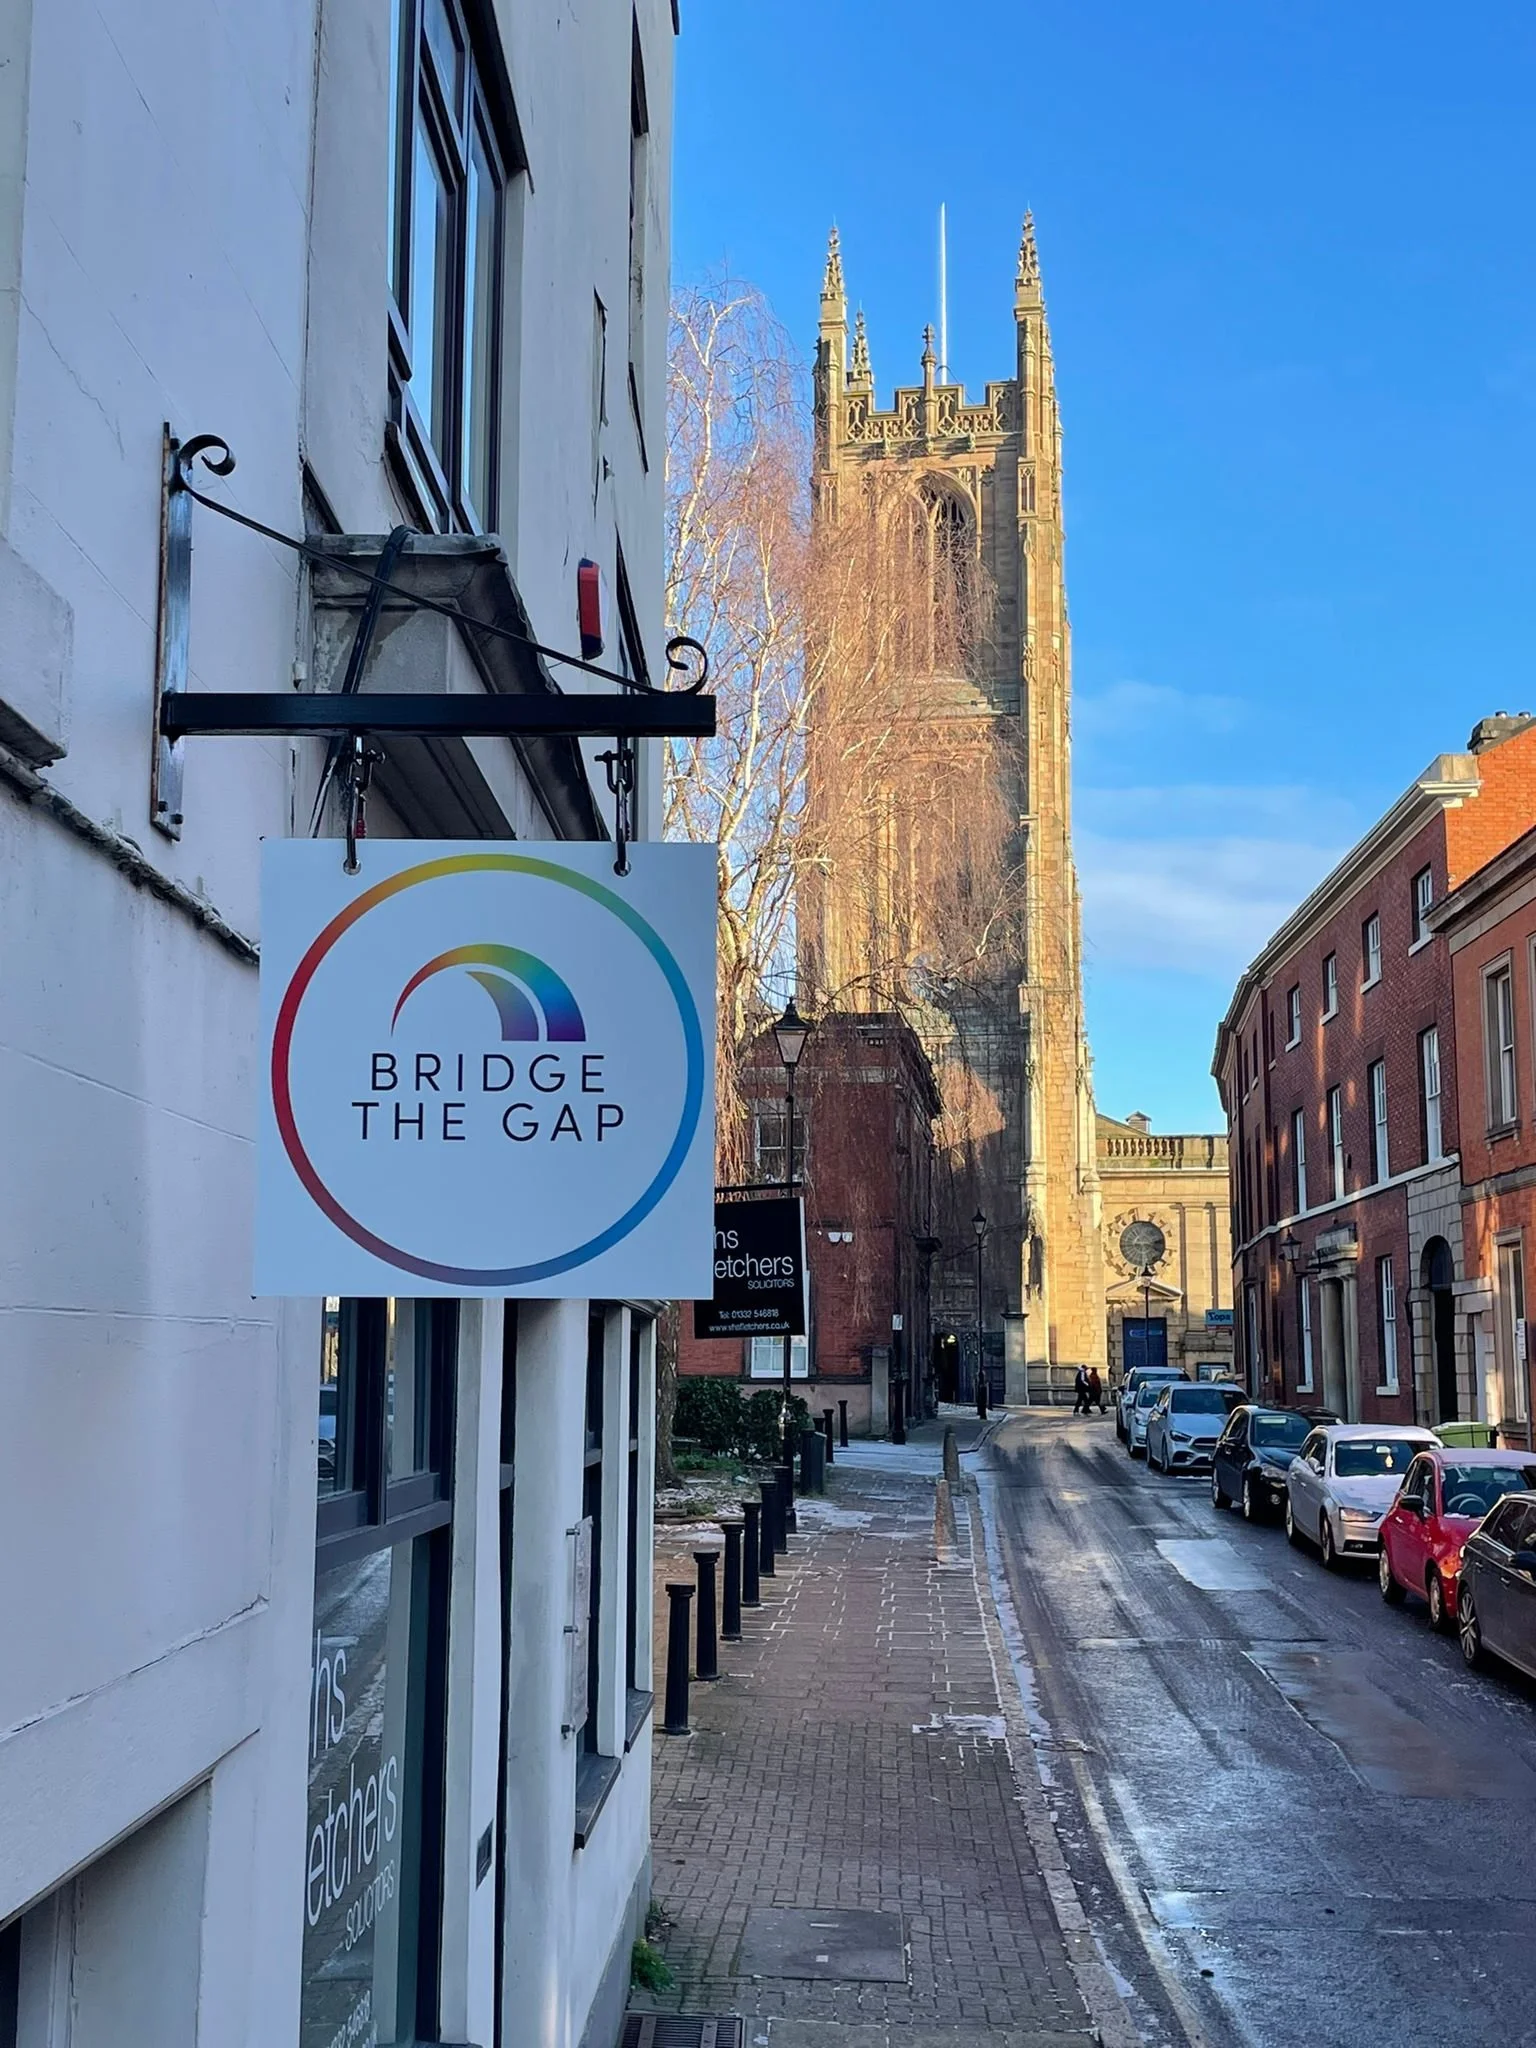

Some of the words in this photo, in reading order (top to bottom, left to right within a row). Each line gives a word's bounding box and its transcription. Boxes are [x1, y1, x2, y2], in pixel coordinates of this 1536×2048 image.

[371, 1052, 605, 1093] BRIDGE
[351, 1101, 467, 1141] THE
[502, 1102, 624, 1142] GAP
[714, 1226, 739, 1249] hs
[714, 1253, 794, 1279] etchers
[747, 1278, 795, 1290] SOLICITORS
[311, 1629, 347, 1759] hs
[308, 1755, 398, 1926] etchers
[345, 1858, 395, 1952] SOLICITORS
